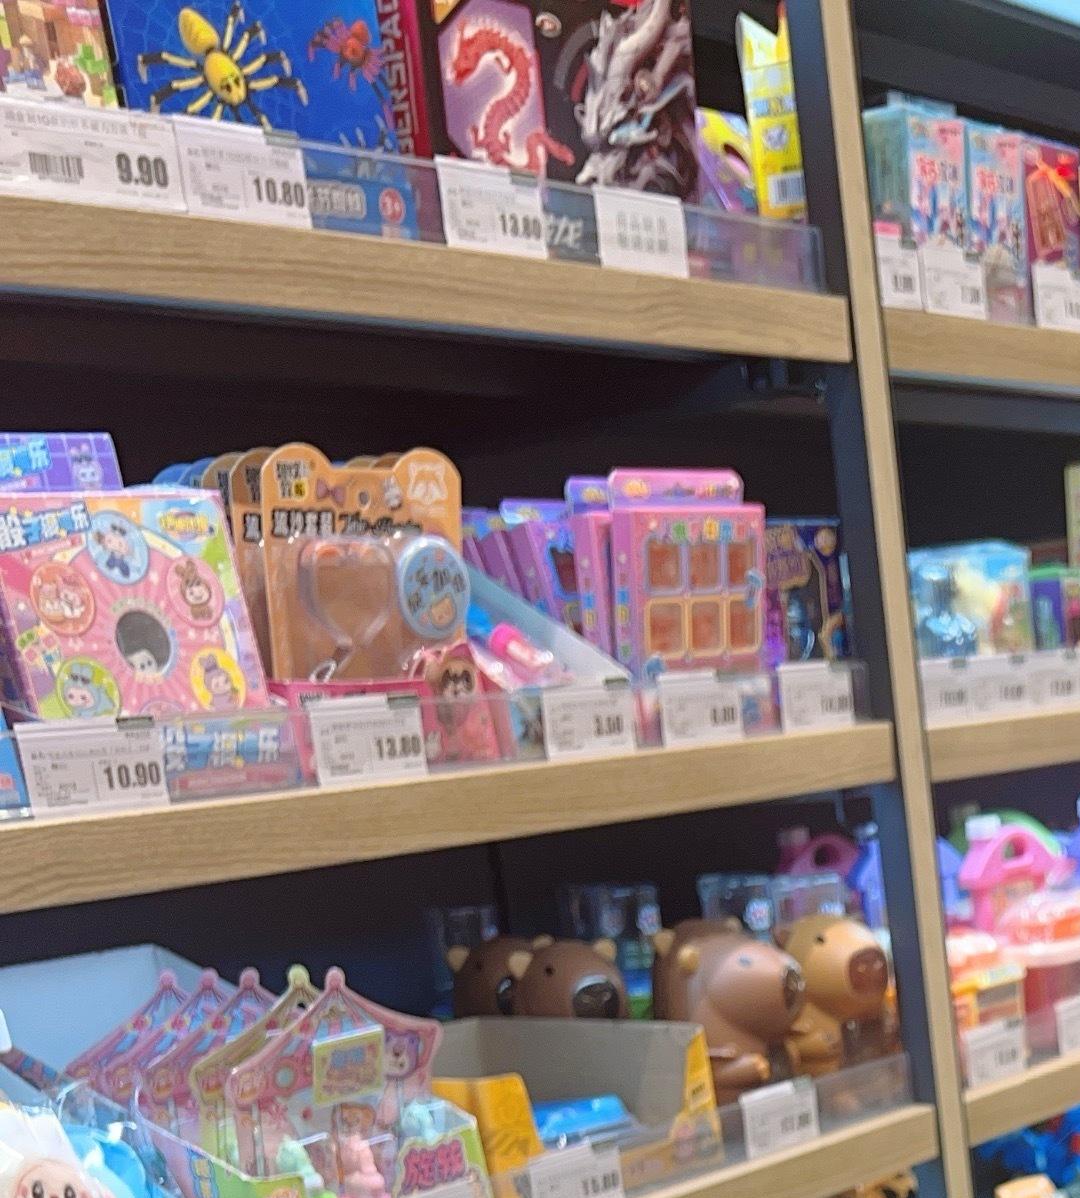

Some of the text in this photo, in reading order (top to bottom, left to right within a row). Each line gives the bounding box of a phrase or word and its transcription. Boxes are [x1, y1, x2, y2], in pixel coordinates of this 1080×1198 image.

[116, 153, 169, 189] 9.90
[253, 176, 305, 208] 10.80
[103, 761, 161, 790] 10.90
